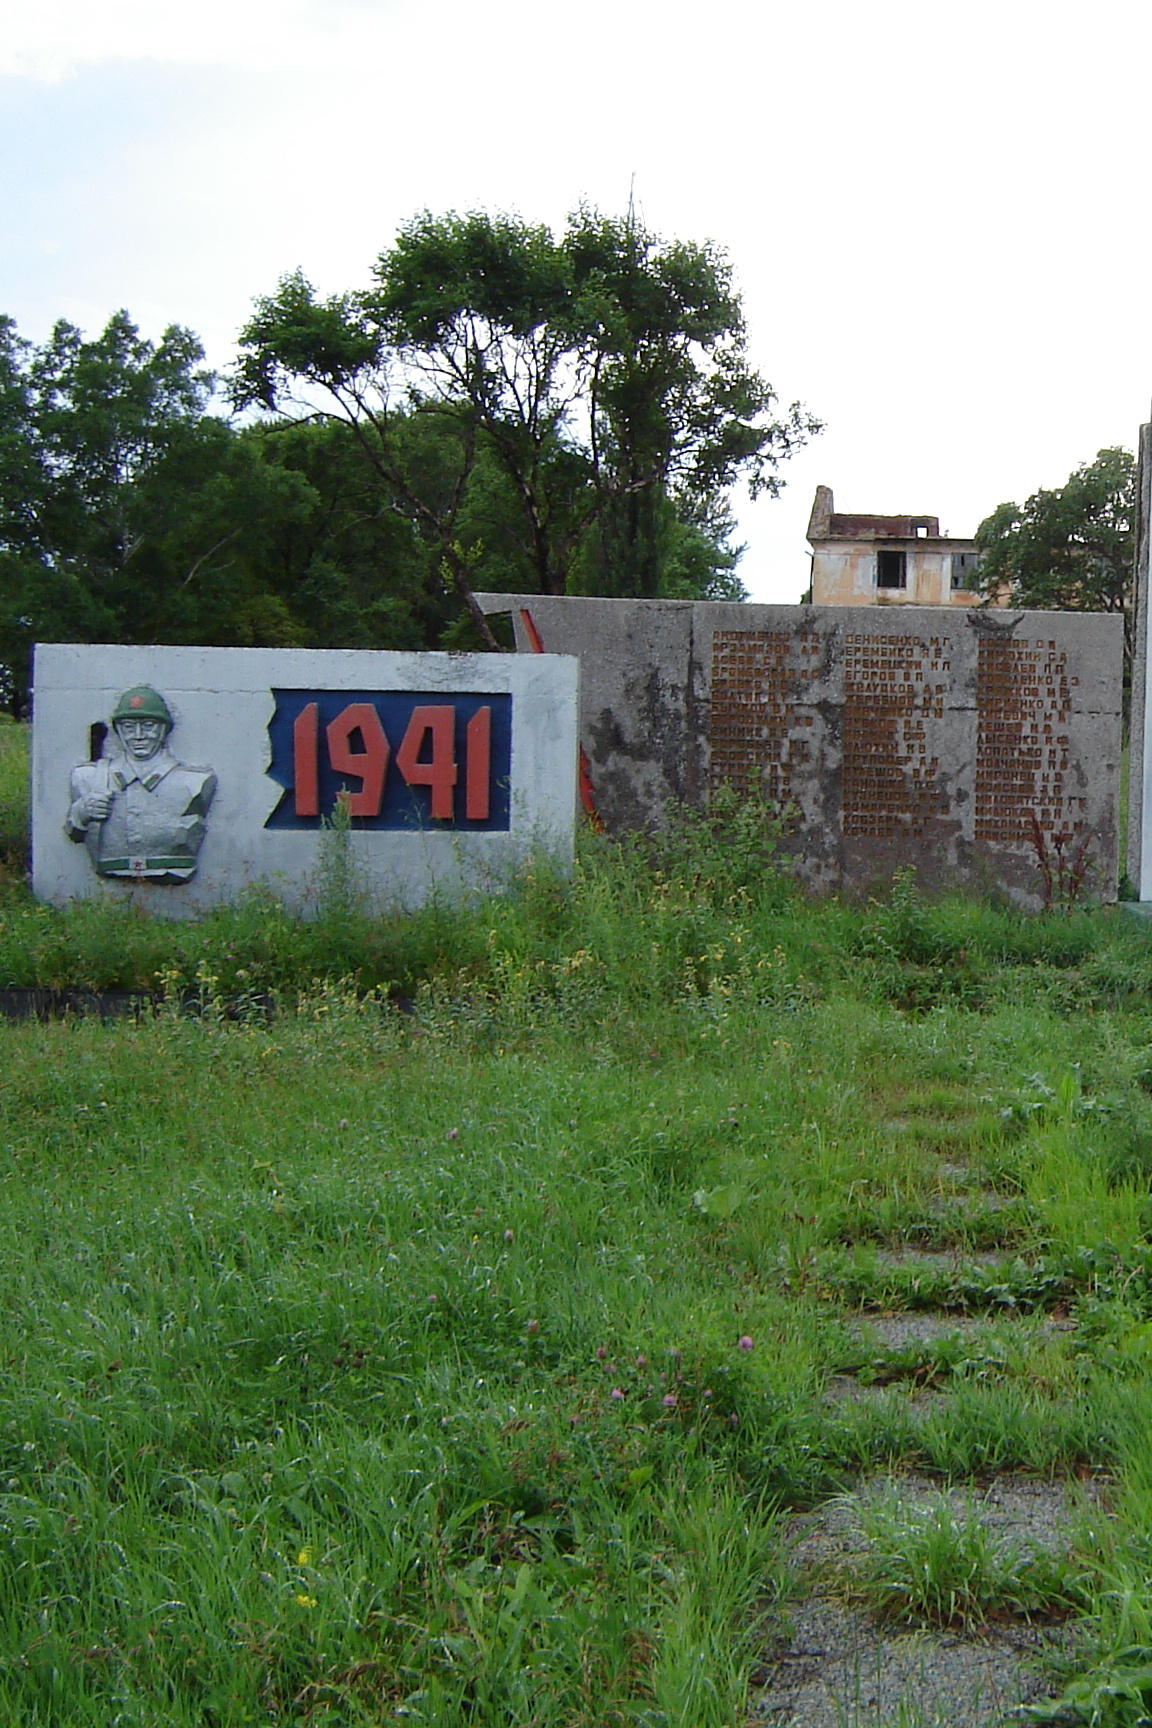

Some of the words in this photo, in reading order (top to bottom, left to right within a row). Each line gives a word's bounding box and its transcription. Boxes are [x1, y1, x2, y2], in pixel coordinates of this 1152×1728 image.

[846, 635, 921, 646] ДЕНИСЕНКО
[979, 662, 1036, 674] КИСЕЛЕВ
[846, 671, 895, 681] ЕГОРОВ
[979, 674, 1053, 686] КОВАЛЕНКО
[978, 734, 1038, 746] ЛЫСЕНКО
[978, 746, 1042, 758] ЛОПАТЬКО
[293, 702, 491, 819] 1941
[977, 758, 1041, 770] МОЛЧАНОВ
[976, 818, 1054, 830] МИХАЙЛЕКО
